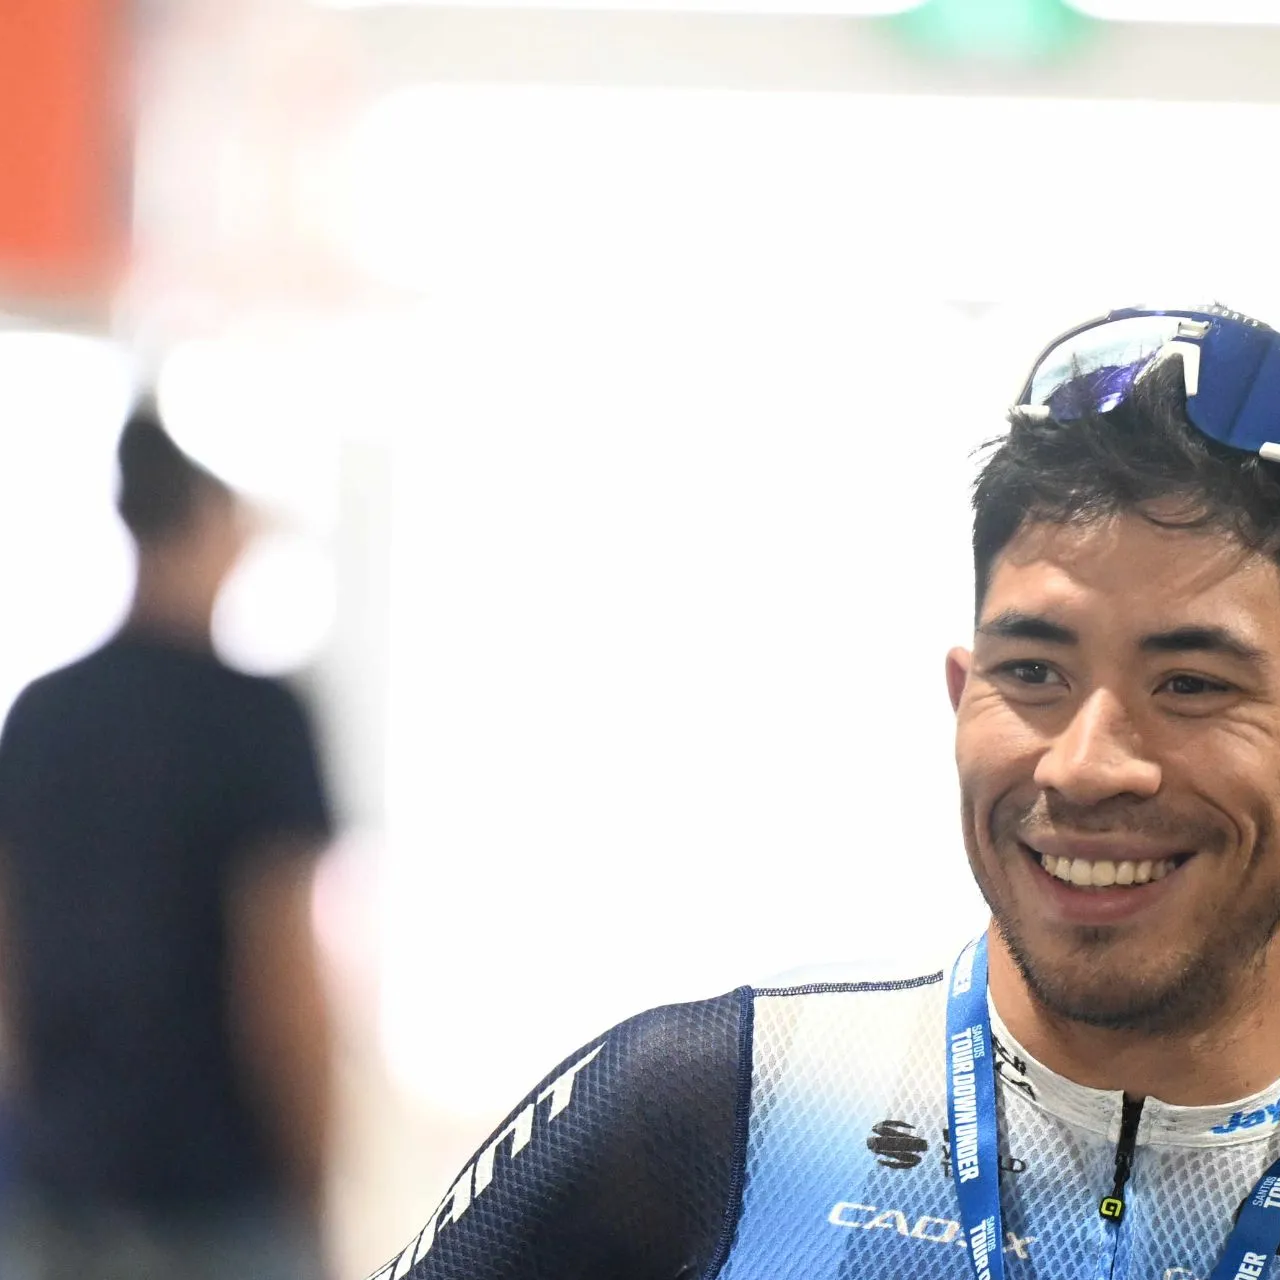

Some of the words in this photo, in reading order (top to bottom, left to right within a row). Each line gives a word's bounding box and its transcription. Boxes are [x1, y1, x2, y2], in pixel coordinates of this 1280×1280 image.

[951, 1027, 976, 1075] TOUR
[972, 1024, 987, 1059] SANTOS
[953, 1072, 978, 1126] DOWN
[955, 1122, 980, 1183] UNDER
[1252, 1174, 1277, 1207] SANTOS
[828, 1202, 1036, 1259] CADX
[970, 1219, 990, 1274] TOUR
[987, 1215, 998, 1252] SANTOS
